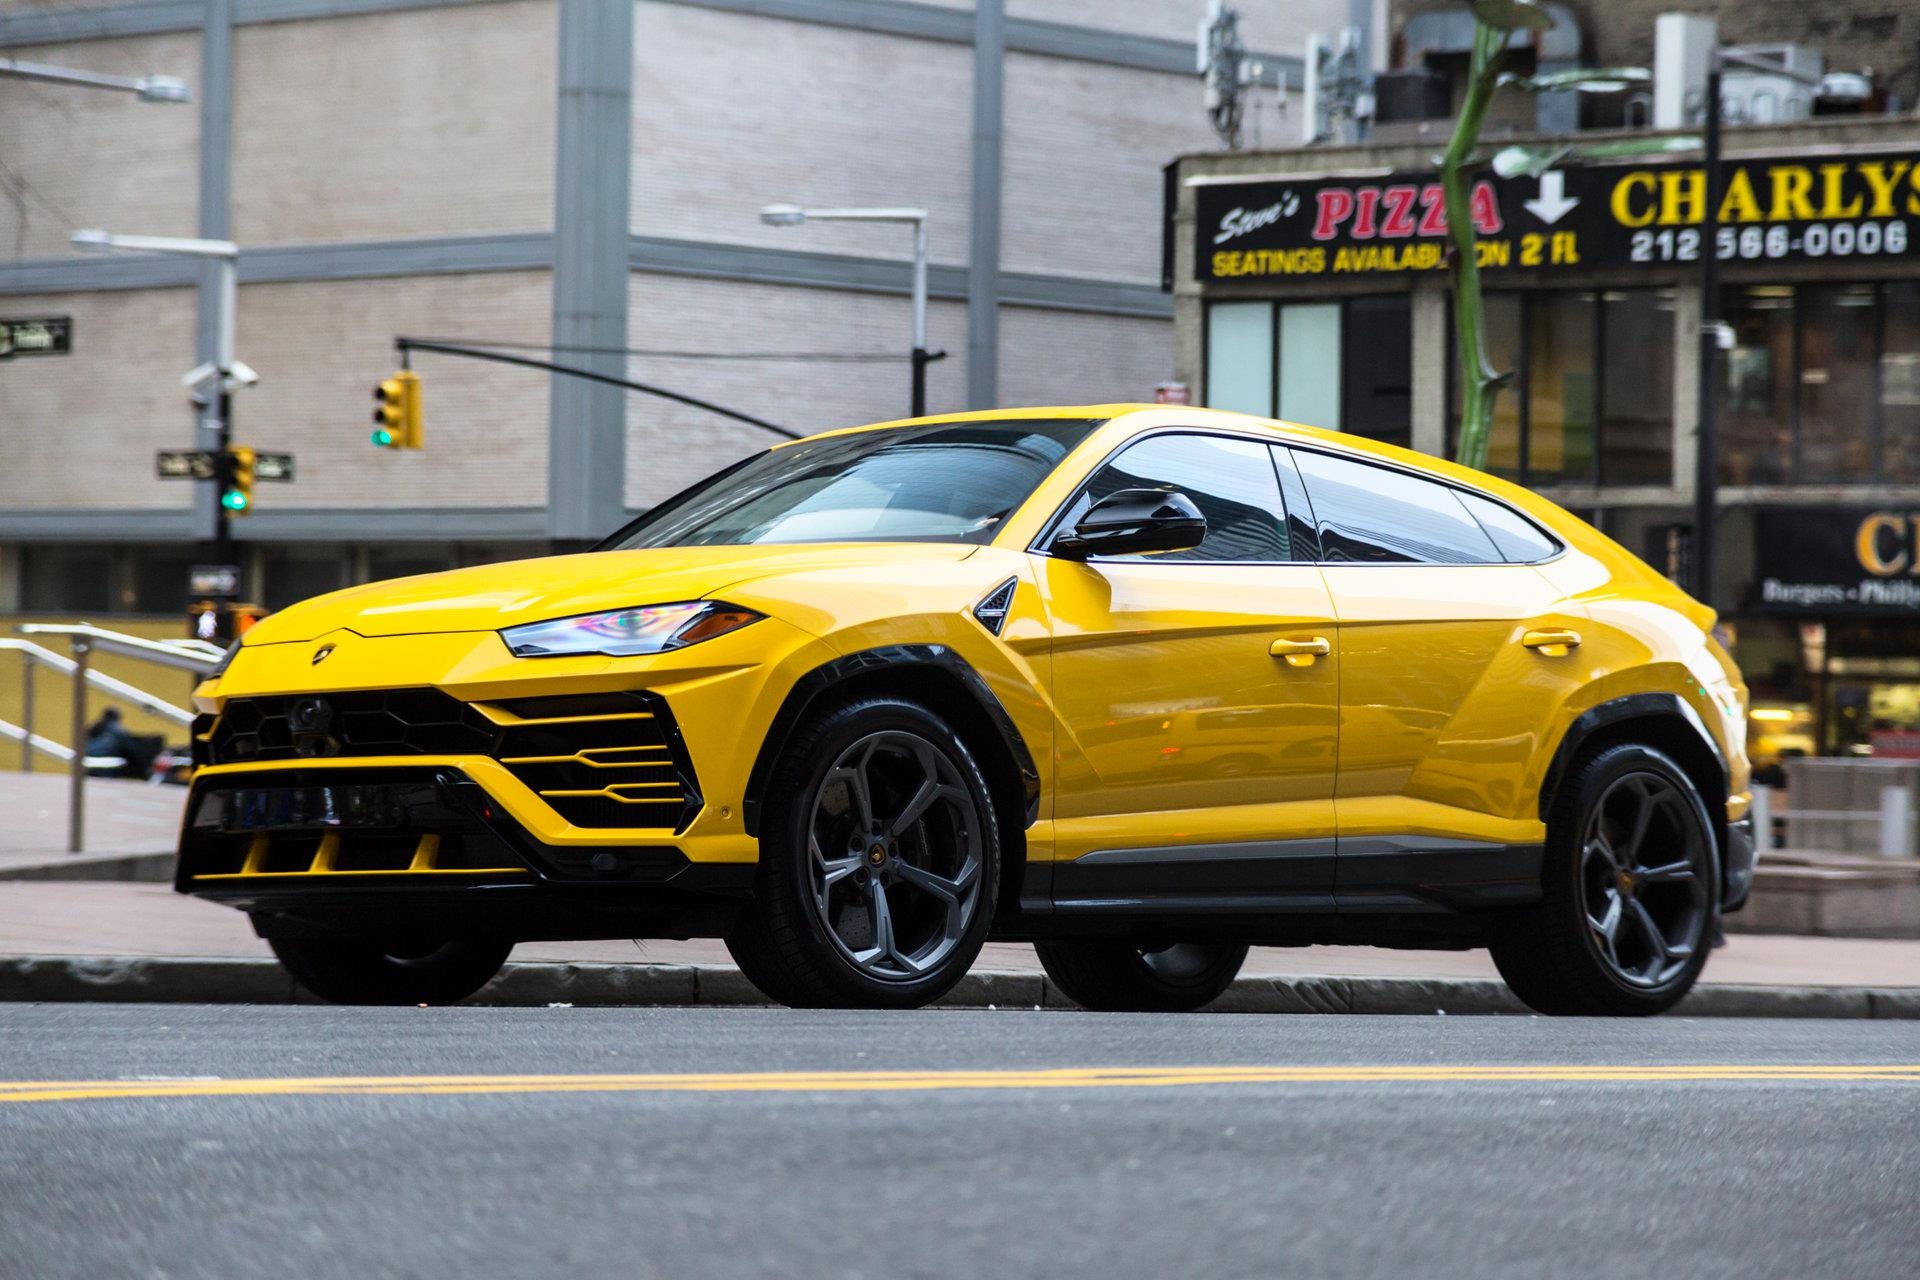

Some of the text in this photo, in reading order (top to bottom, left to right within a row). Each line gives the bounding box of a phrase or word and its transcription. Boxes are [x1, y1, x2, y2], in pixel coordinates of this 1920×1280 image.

[1311, 180, 1503, 241] PIZZA
[1212, 247, 1326, 277] SEATINGS
[1332, 242, 1450, 272] AVAILABL
[1855, 513, 1920, 576] C
